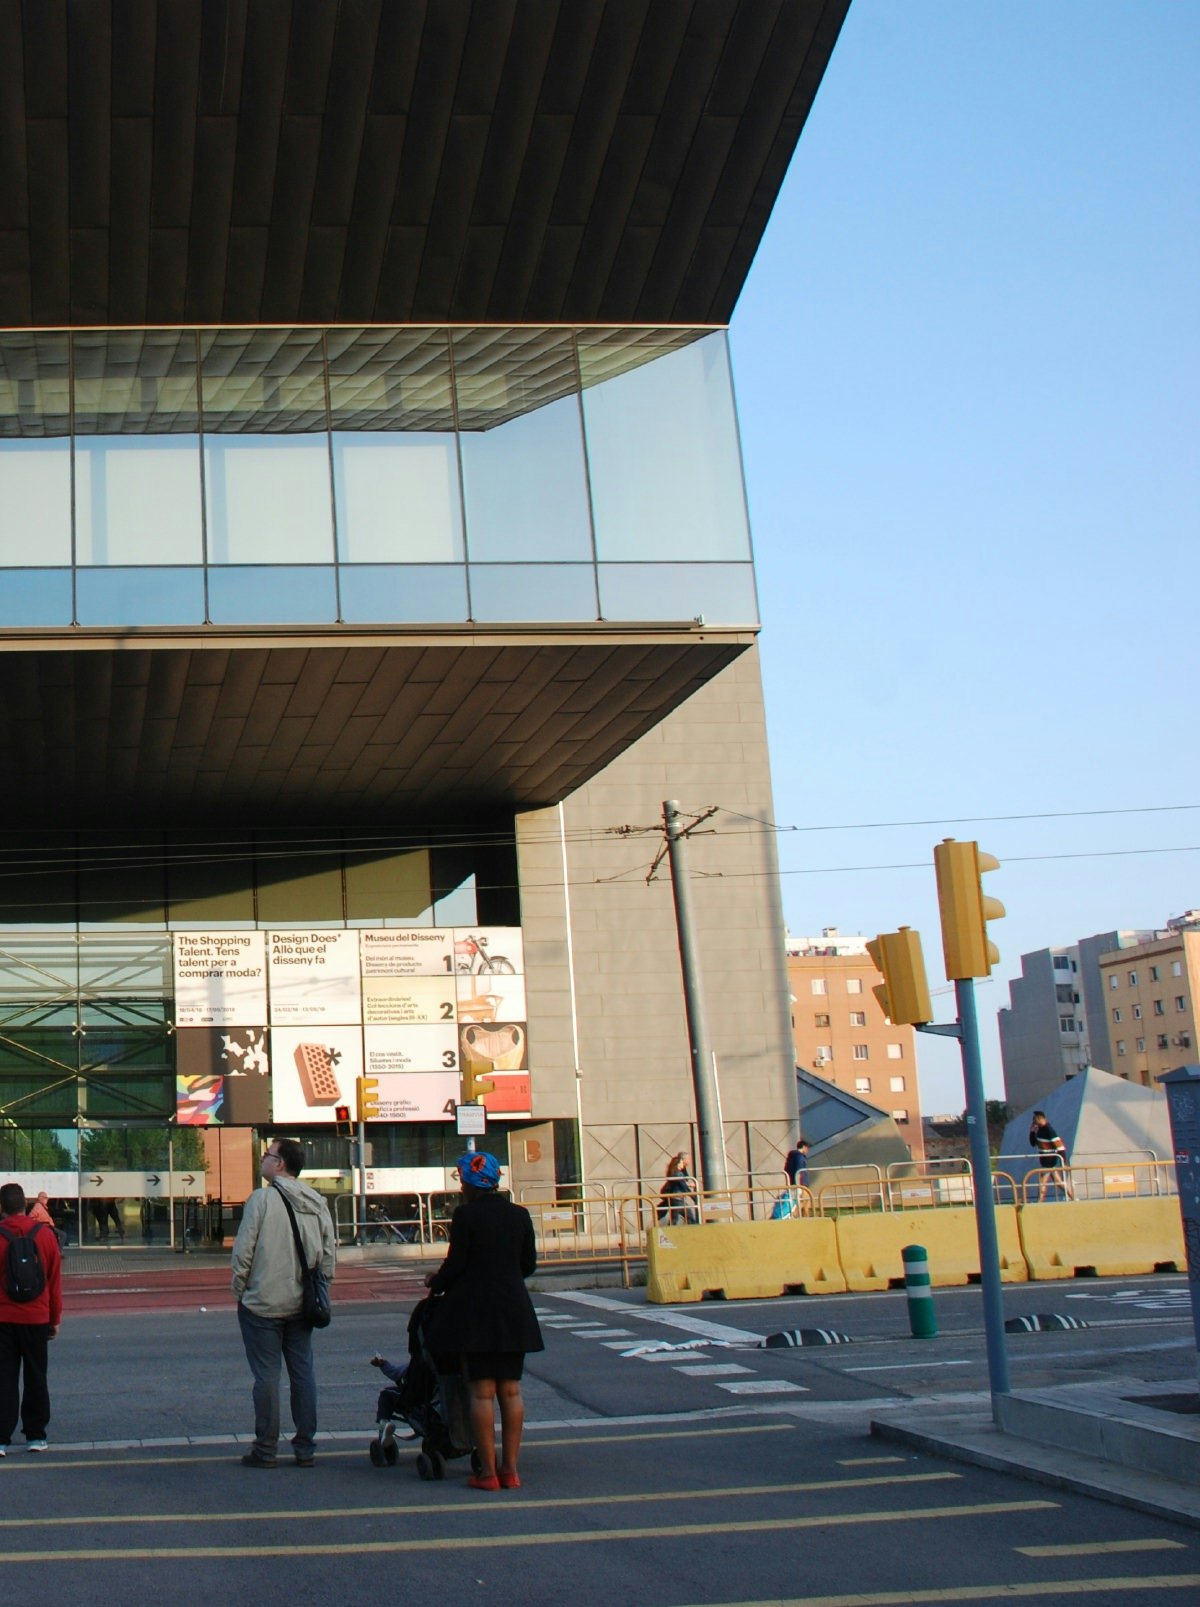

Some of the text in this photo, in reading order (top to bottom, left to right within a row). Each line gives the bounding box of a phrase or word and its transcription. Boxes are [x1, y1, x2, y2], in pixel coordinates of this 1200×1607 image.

[178, 936, 251, 946] The Shopping
[272, 934, 308, 944] Design
[365, 934, 394, 942] Museu
[411, 933, 445, 942] Disseny
[179, 947, 240, 956] Talent. Tens
[273, 945, 326, 955] Allò que el
[179, 958, 209, 967] talent
[211, 959, 228, 968] per
[273, 955, 325, 966] disseny fa
[443, 955, 452, 972] 1
[179, 968, 261, 979] comprar moda?
[440, 1002, 454, 1019] 2
[442, 1050, 456, 1068] 3
[442, 1099, 456, 1117] 4
